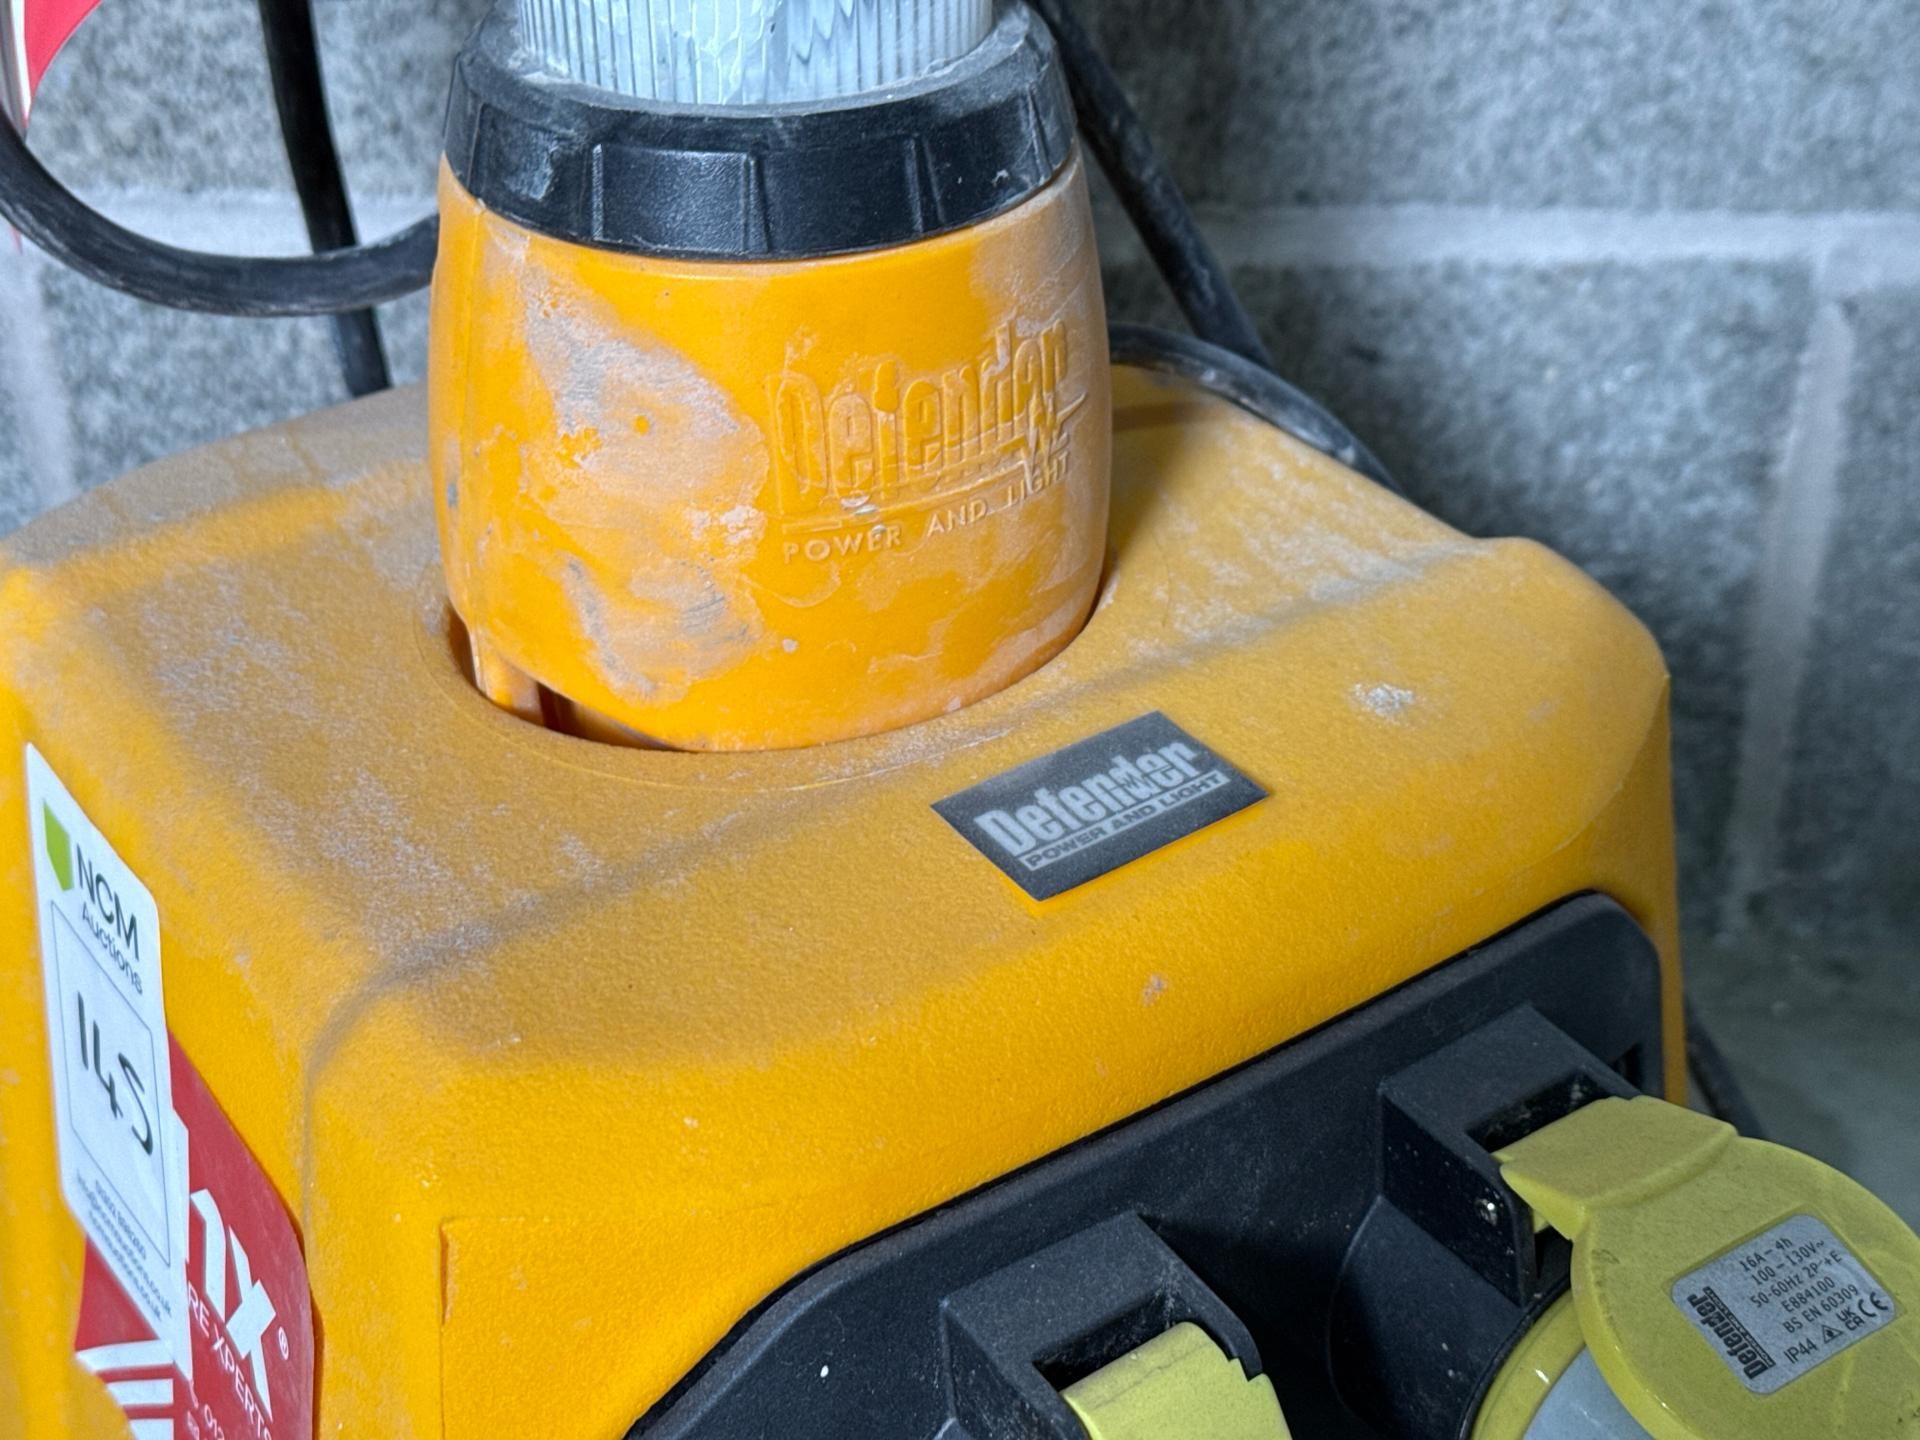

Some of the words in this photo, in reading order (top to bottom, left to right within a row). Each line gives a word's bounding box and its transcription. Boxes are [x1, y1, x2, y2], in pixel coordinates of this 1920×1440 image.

[768, 318, 1069, 516] Defender
[783, 526, 902, 563] POWER
[926, 499, 988, 538] AND
[1007, 449, 1070, 507] LIGHT
[973, 741, 1200, 857] Defender
[1027, 825, 1108, 867] POWER
[1111, 803, 1156, 831] AND
[1164, 774, 1223, 804] LIGHT
[76, 843, 139, 962] NCM
[82, 902, 143, 995] Auctions
[1739, 1251, 1767, 1272] 16A
[1775, 1237, 1793, 1252] 4h
[1750, 1274, 1804, 1308] 50-60Hz
[1752, 1265, 1777, 1286] 100
[1781, 1276, 1836, 1313] E884100
[1687, 1293, 1769, 1380] Defender
[1782, 1318, 1803, 1334] BS
[1802, 1306, 1822, 1323] EN
[1822, 1284, 1859, 1312] 60309
[1783, 1338, 1819, 1364] IP44
